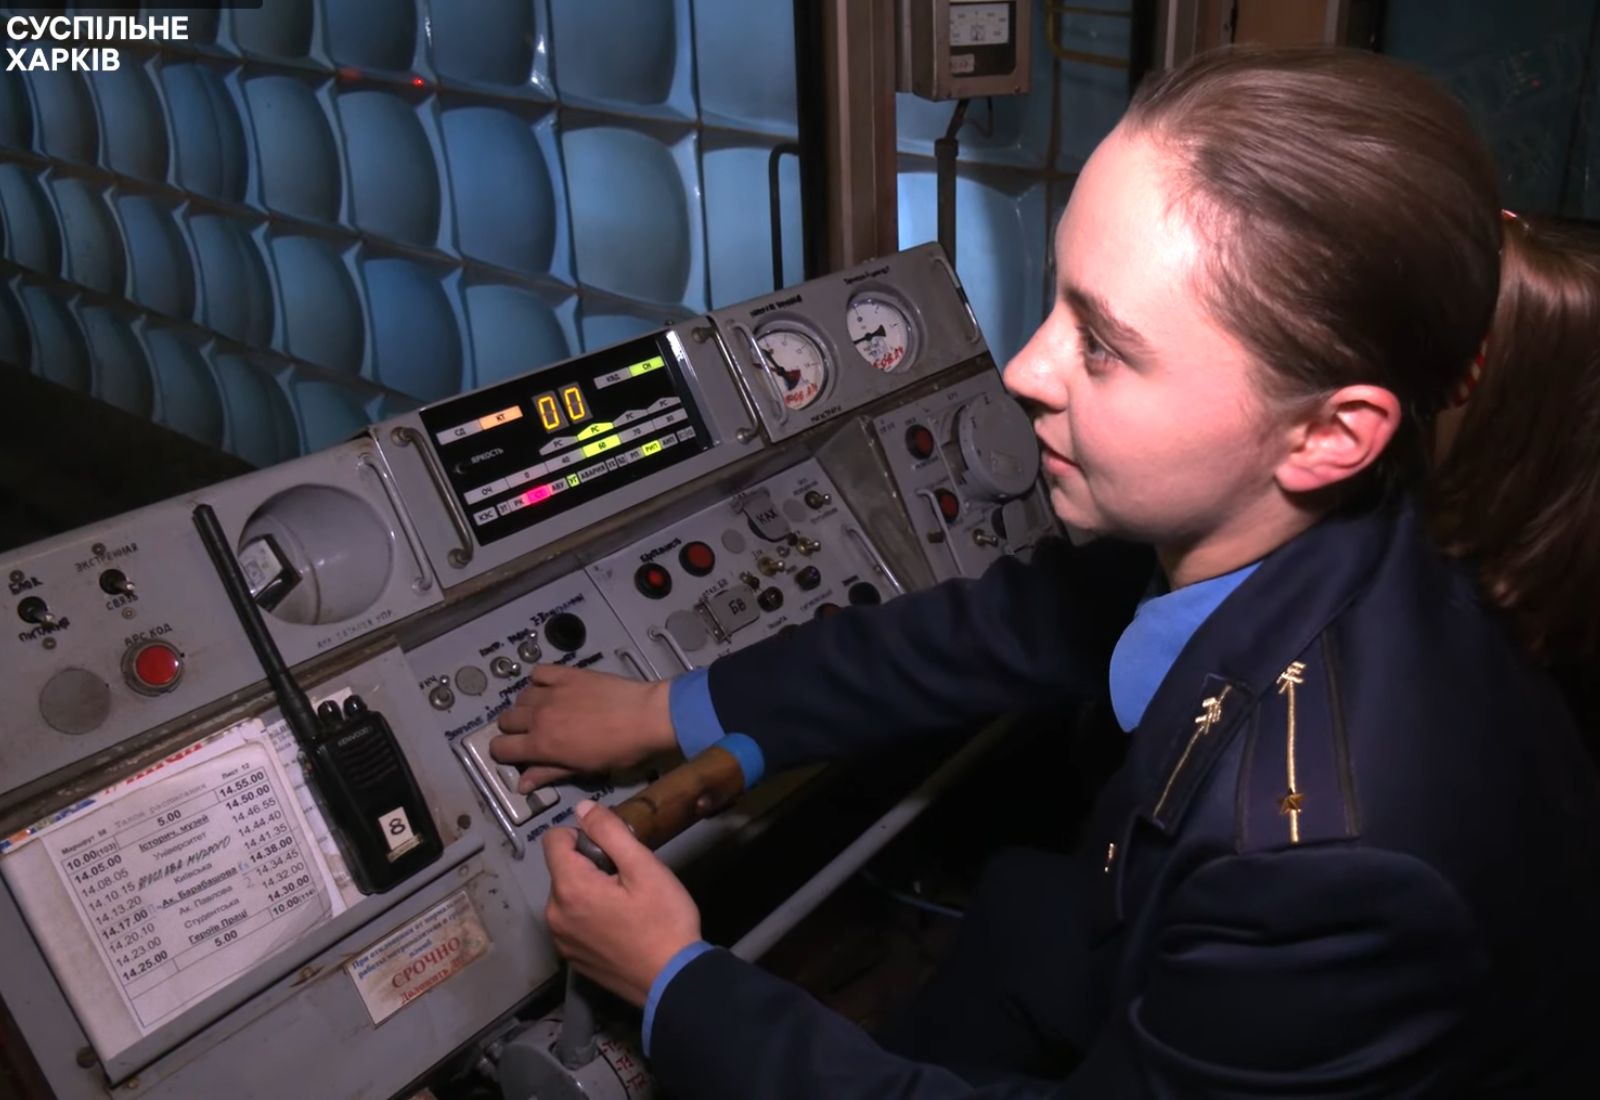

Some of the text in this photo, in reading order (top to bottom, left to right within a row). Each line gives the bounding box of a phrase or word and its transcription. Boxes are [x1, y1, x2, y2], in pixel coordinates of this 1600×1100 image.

[454, 427, 466, 437] СД
[471, 448, 504, 465] ЯРКОСТЬ
[75, 855, 121, 883] 14.05.00
[180, 816, 208, 832] музей
[226, 785, 270, 810] 14.50.00
[82, 869, 128, 897] 14.08.05
[232, 798, 276, 822] 14.46.55
[157, 810, 181, 826] 5.00
[220, 772, 264, 796] 14.55.00
[390, 818, 406, 836] 8
[89, 811, 281, 911] 14.10.15 14.44.40
[96, 896, 142, 925] 14.13.20
[244, 824, 287, 849] 14.41.35
[102, 909, 148, 939] 14.17.00
[250, 836, 292, 862] 14.38.00
[110, 923, 154, 952] 14.20.10
[256, 850, 298, 875] 14.34.45
[116, 937, 161, 966] 14.23.00
[262, 862, 304, 888] 14.32.00
[123, 950, 167, 980] 14.25.00
[268, 875, 309, 901] 14.30.00
[214, 930, 237, 946] 5.00
[392, 937, 460, 988] СРОЧНО
